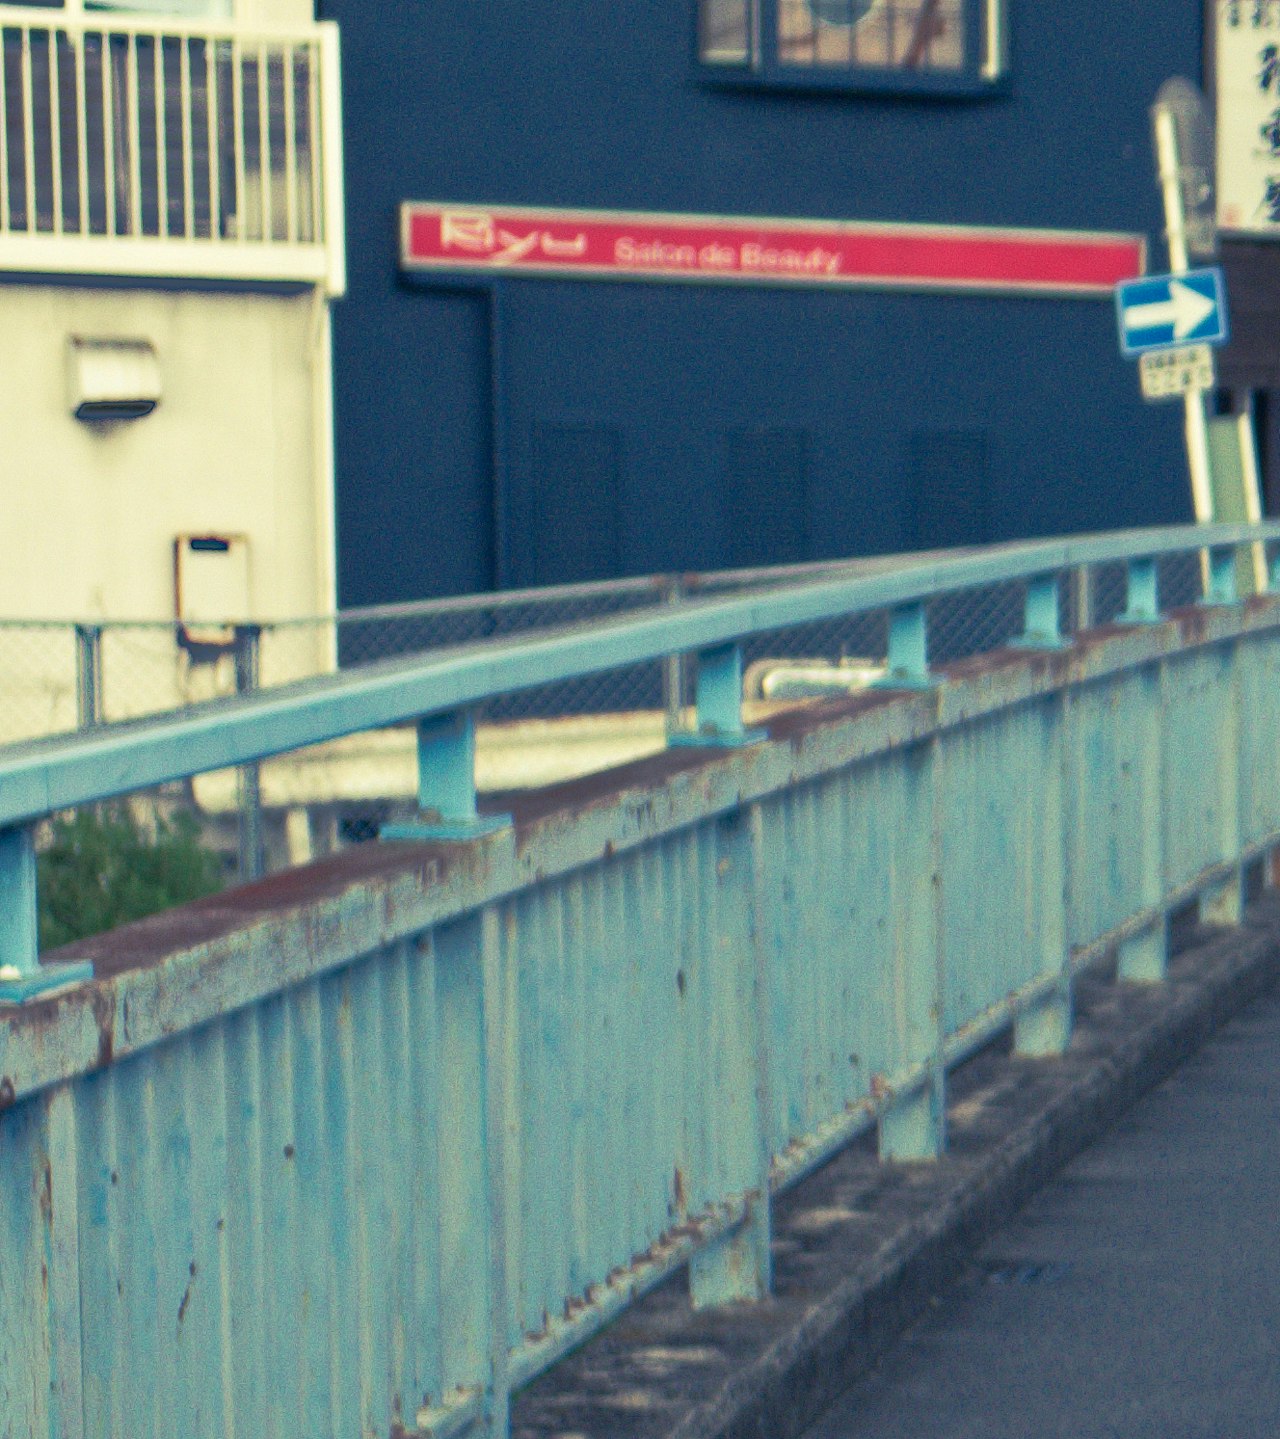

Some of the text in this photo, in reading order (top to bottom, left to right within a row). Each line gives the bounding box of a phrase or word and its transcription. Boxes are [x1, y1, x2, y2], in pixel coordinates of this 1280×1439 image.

[439, 210, 588, 267] Ryu
[614, 235, 842, 274] Salon de Beauty
